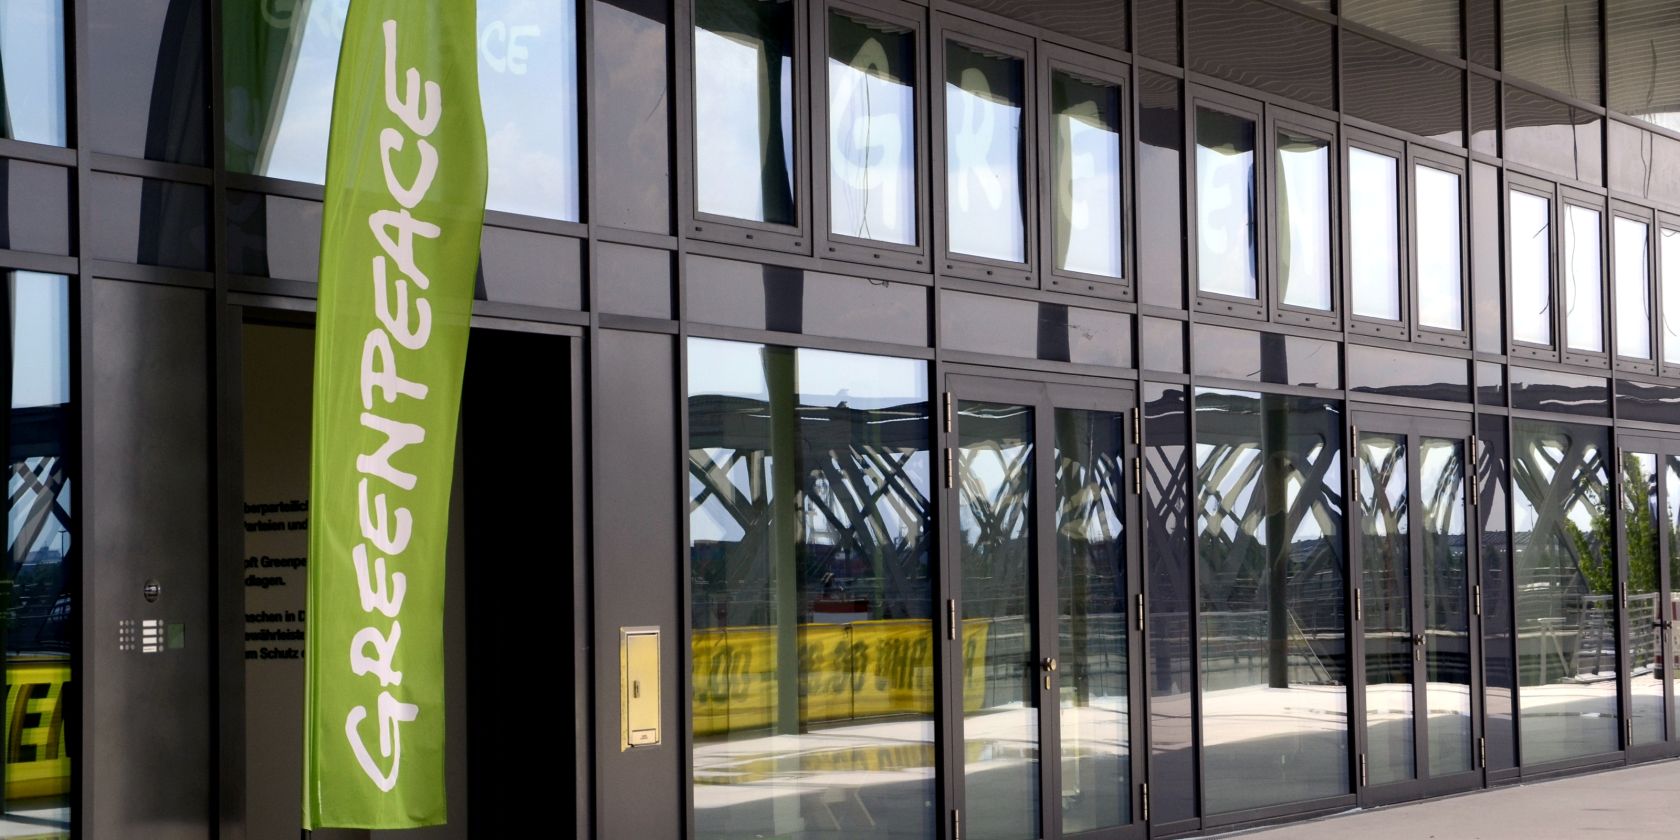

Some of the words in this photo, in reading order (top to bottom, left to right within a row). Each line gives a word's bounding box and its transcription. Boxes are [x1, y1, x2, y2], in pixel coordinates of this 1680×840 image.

[345, 20, 442, 793] GREENPEACE
[244, 519, 285, 532] arteien
[260, 648, 298, 659] Schutz
